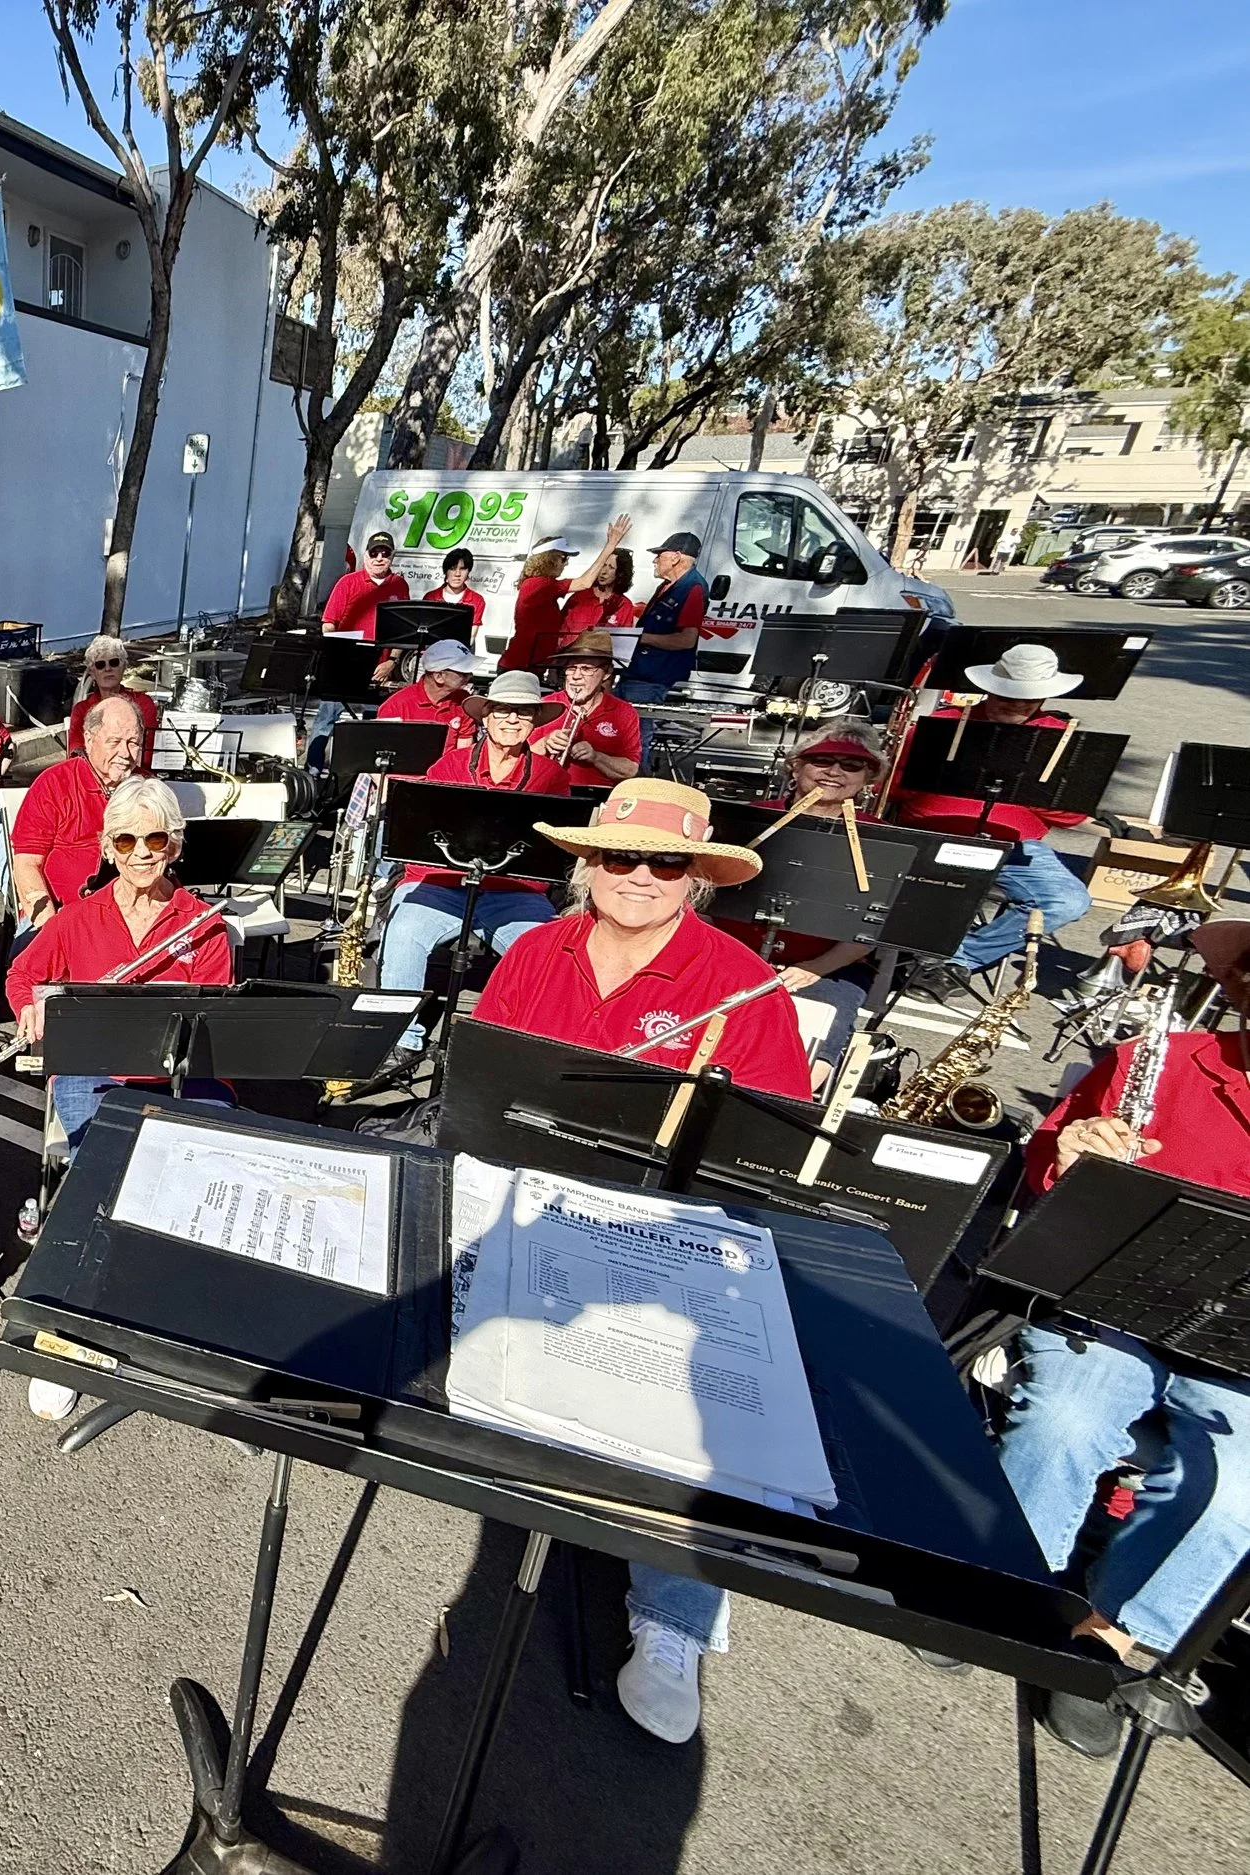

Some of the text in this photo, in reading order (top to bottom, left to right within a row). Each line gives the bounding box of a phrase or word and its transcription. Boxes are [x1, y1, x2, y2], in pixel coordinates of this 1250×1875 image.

[470, 527, 520, 537] IN-TOWN
[408, 571, 432, 580] Share
[1104, 876, 1151, 888] COMP
[633, 1010, 680, 1031] LAGUNA
[736, 1157, 775, 1174] Laguna
[846, 1185, 891, 1204] Concert
[894, 1198, 928, 1212] Band
[552, 1183, 614, 1206] SYMPHONIC
[618, 1202, 649, 1216] BAND
[543, 1202, 738, 1260] IN THE MILLER MOOD
[600, 1238, 618, 1247] LAST
[608, 1259, 670, 1278] INSTRUMENTATION
[608, 1326, 685, 1352] PERFORMANCE NOTES
